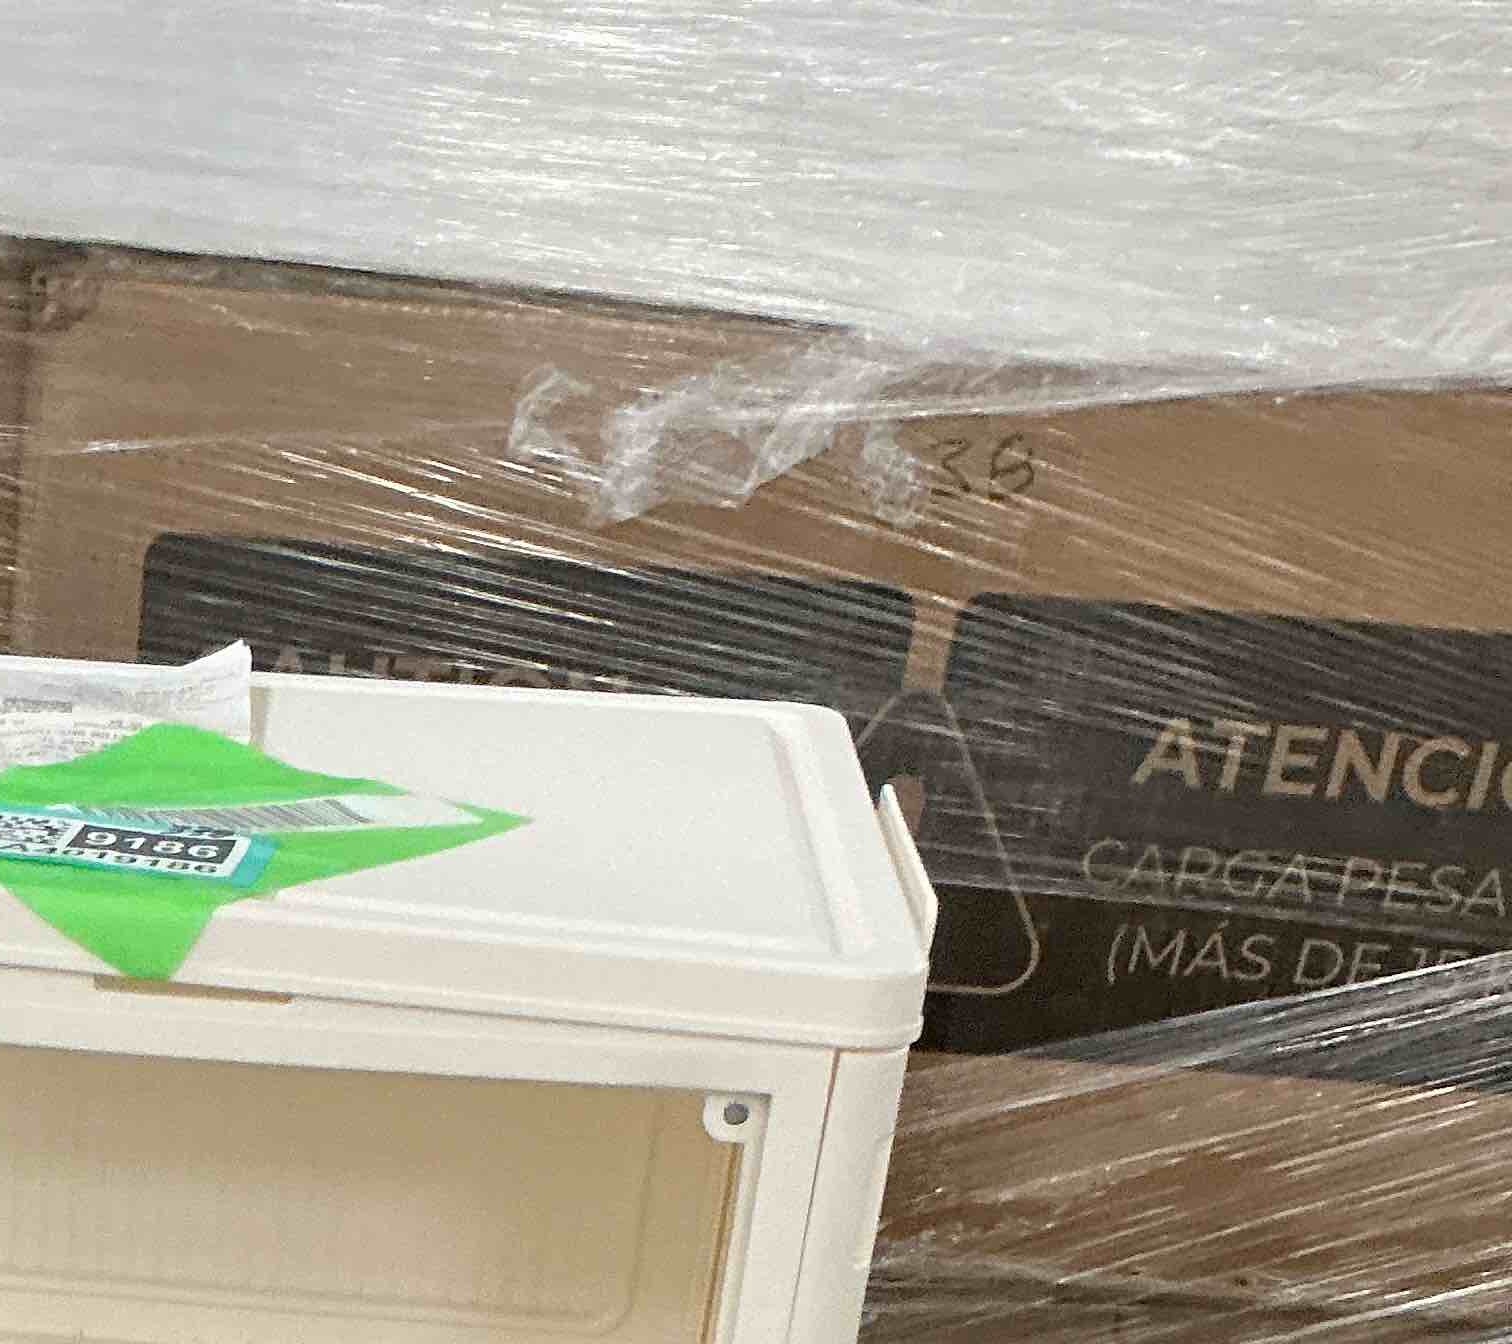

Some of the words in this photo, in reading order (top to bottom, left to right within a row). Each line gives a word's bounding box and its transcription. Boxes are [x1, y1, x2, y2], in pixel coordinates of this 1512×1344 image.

[84, 830, 222, 860] 9186
[1083, 838, 1314, 904] CARGA
[1338, 855, 1507, 917] PESA
[1105, 919, 1275, 986] (MÁS
